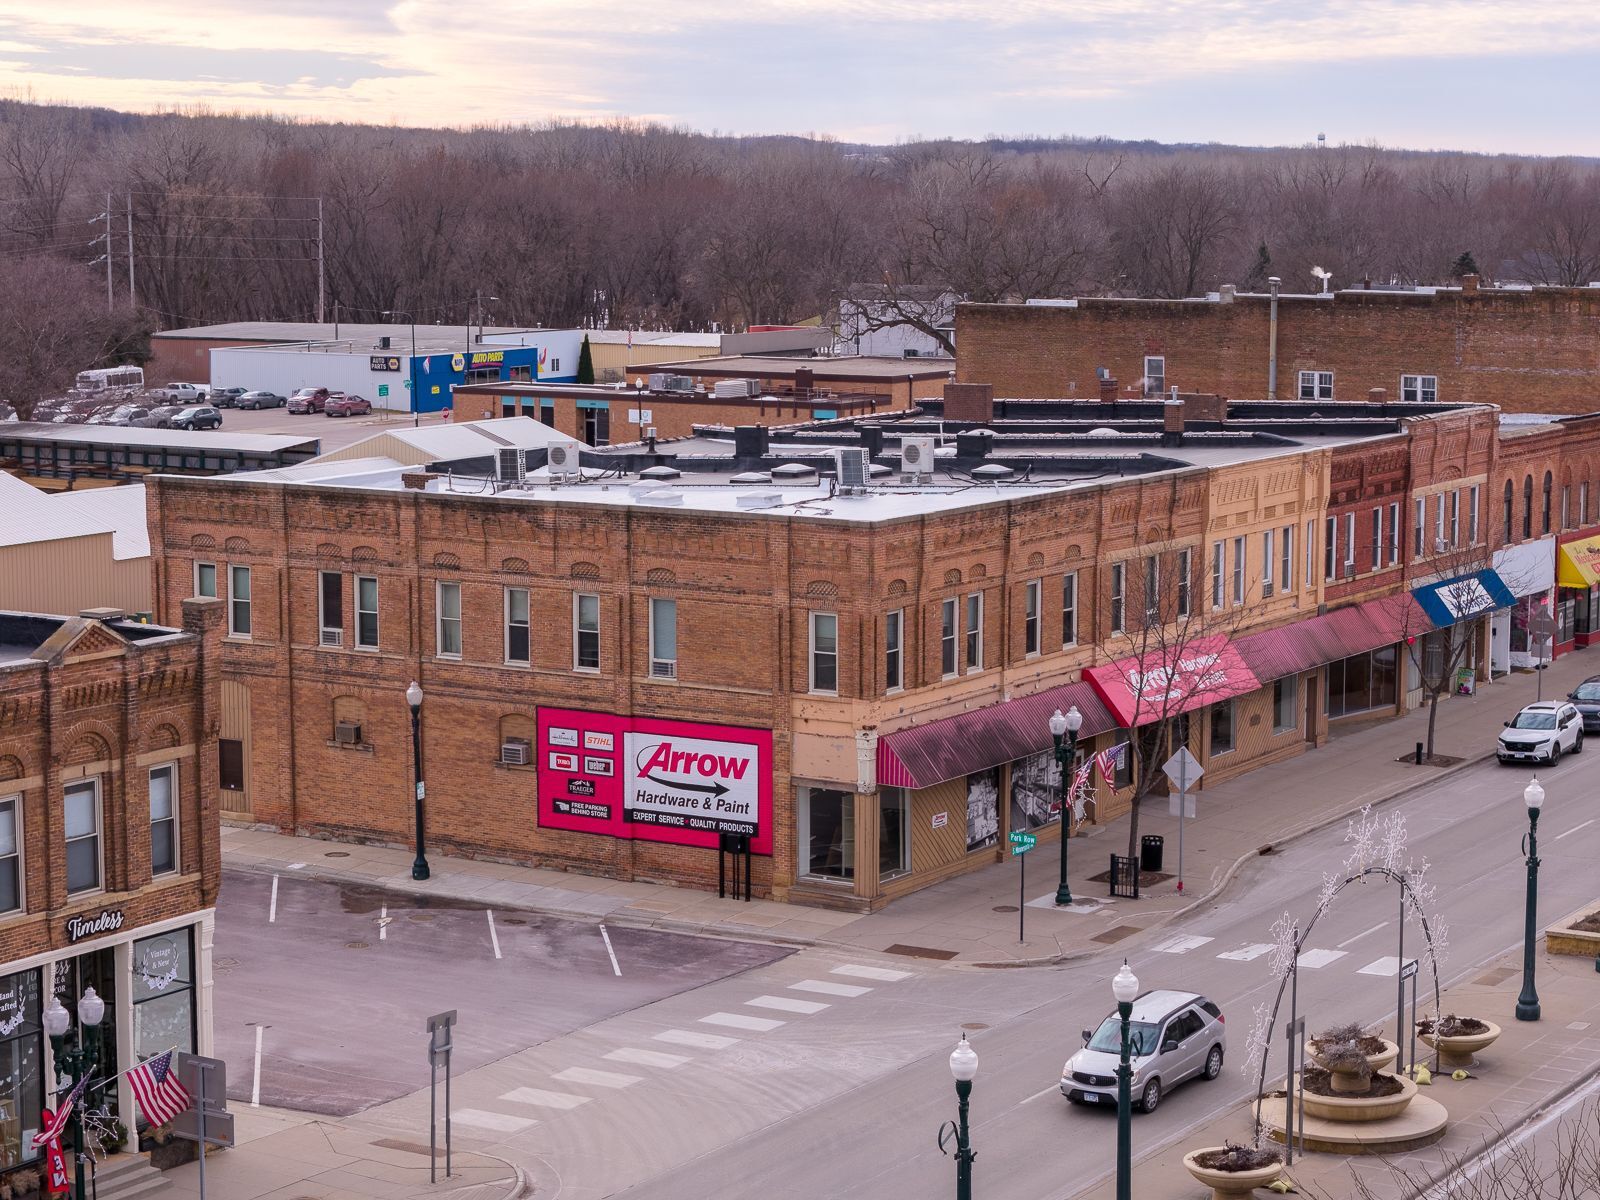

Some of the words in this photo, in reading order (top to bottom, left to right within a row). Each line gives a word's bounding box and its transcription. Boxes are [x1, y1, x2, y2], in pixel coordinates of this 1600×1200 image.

[472, 353, 487, 363] AUTO
[488, 351, 504, 362] PARTS
[587, 736, 611, 746] STIHL
[636, 742, 750, 780] Arrow
[569, 784, 594, 793] TRAEGER
[585, 803, 608, 812] PARKING
[636, 789, 699, 808] Hardware
[702, 797, 712, 810] &
[716, 798, 750, 815] Paint
[571, 808, 590, 816] BEHIND
[591, 810, 608, 818] STORE
[633, 811, 656, 822] EXPERT
[658, 814, 685, 826] SERVICE
[690, 818, 717, 830] QUALITY
[719, 821, 754, 834] PRODUCTS
[1010, 833, 1022, 842] Park
[1024, 835, 1035, 844] Row
[68, 911, 124, 941] Timeless
[150, 948, 171, 959] Vintage
